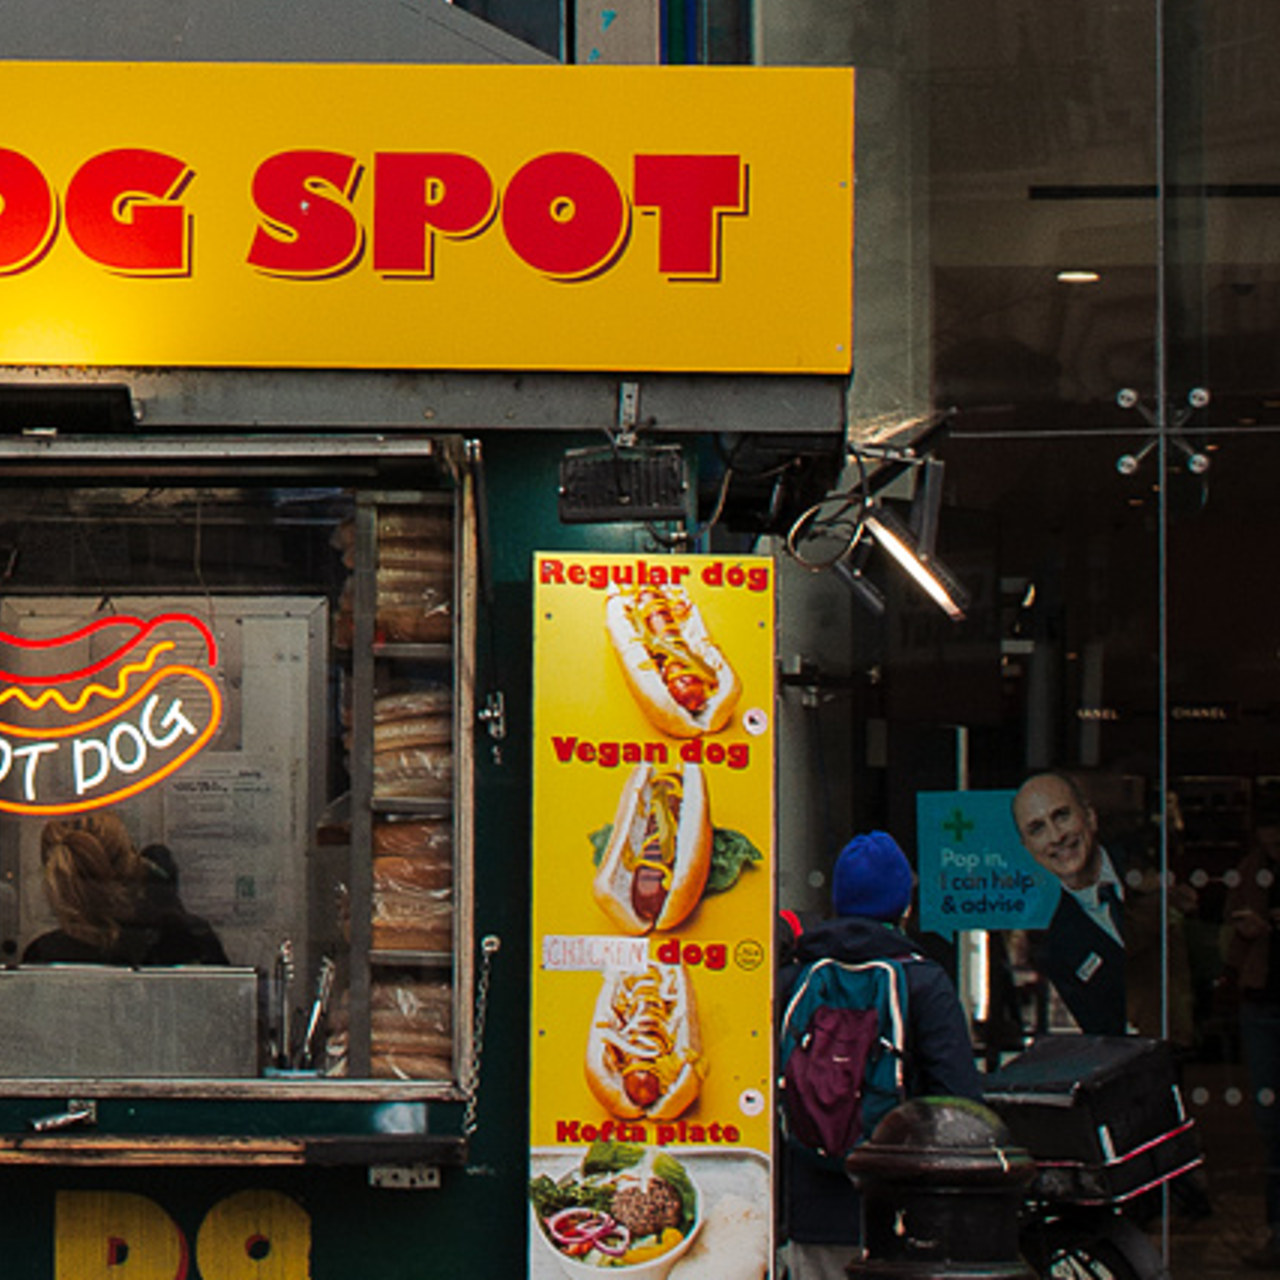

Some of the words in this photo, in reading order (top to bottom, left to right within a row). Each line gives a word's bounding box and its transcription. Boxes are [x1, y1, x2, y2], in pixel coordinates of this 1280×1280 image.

[247, 149, 748, 281] SPOT
[539, 559, 690, 590] Regular
[702, 561, 769, 592] dog
[75, 693, 198, 795] DOG
[551, 736, 668, 768] Vegan
[679, 737, 750, 769] dog
[941, 848, 980, 872] Pop
[951, 877, 987, 890] can
[992, 871, 1035, 893] help
[961, 894, 1025, 914] advise
[657, 939, 728, 970] dog
[556, 1121, 648, 1144] Kofta
[655, 1122, 740, 1146] plate
